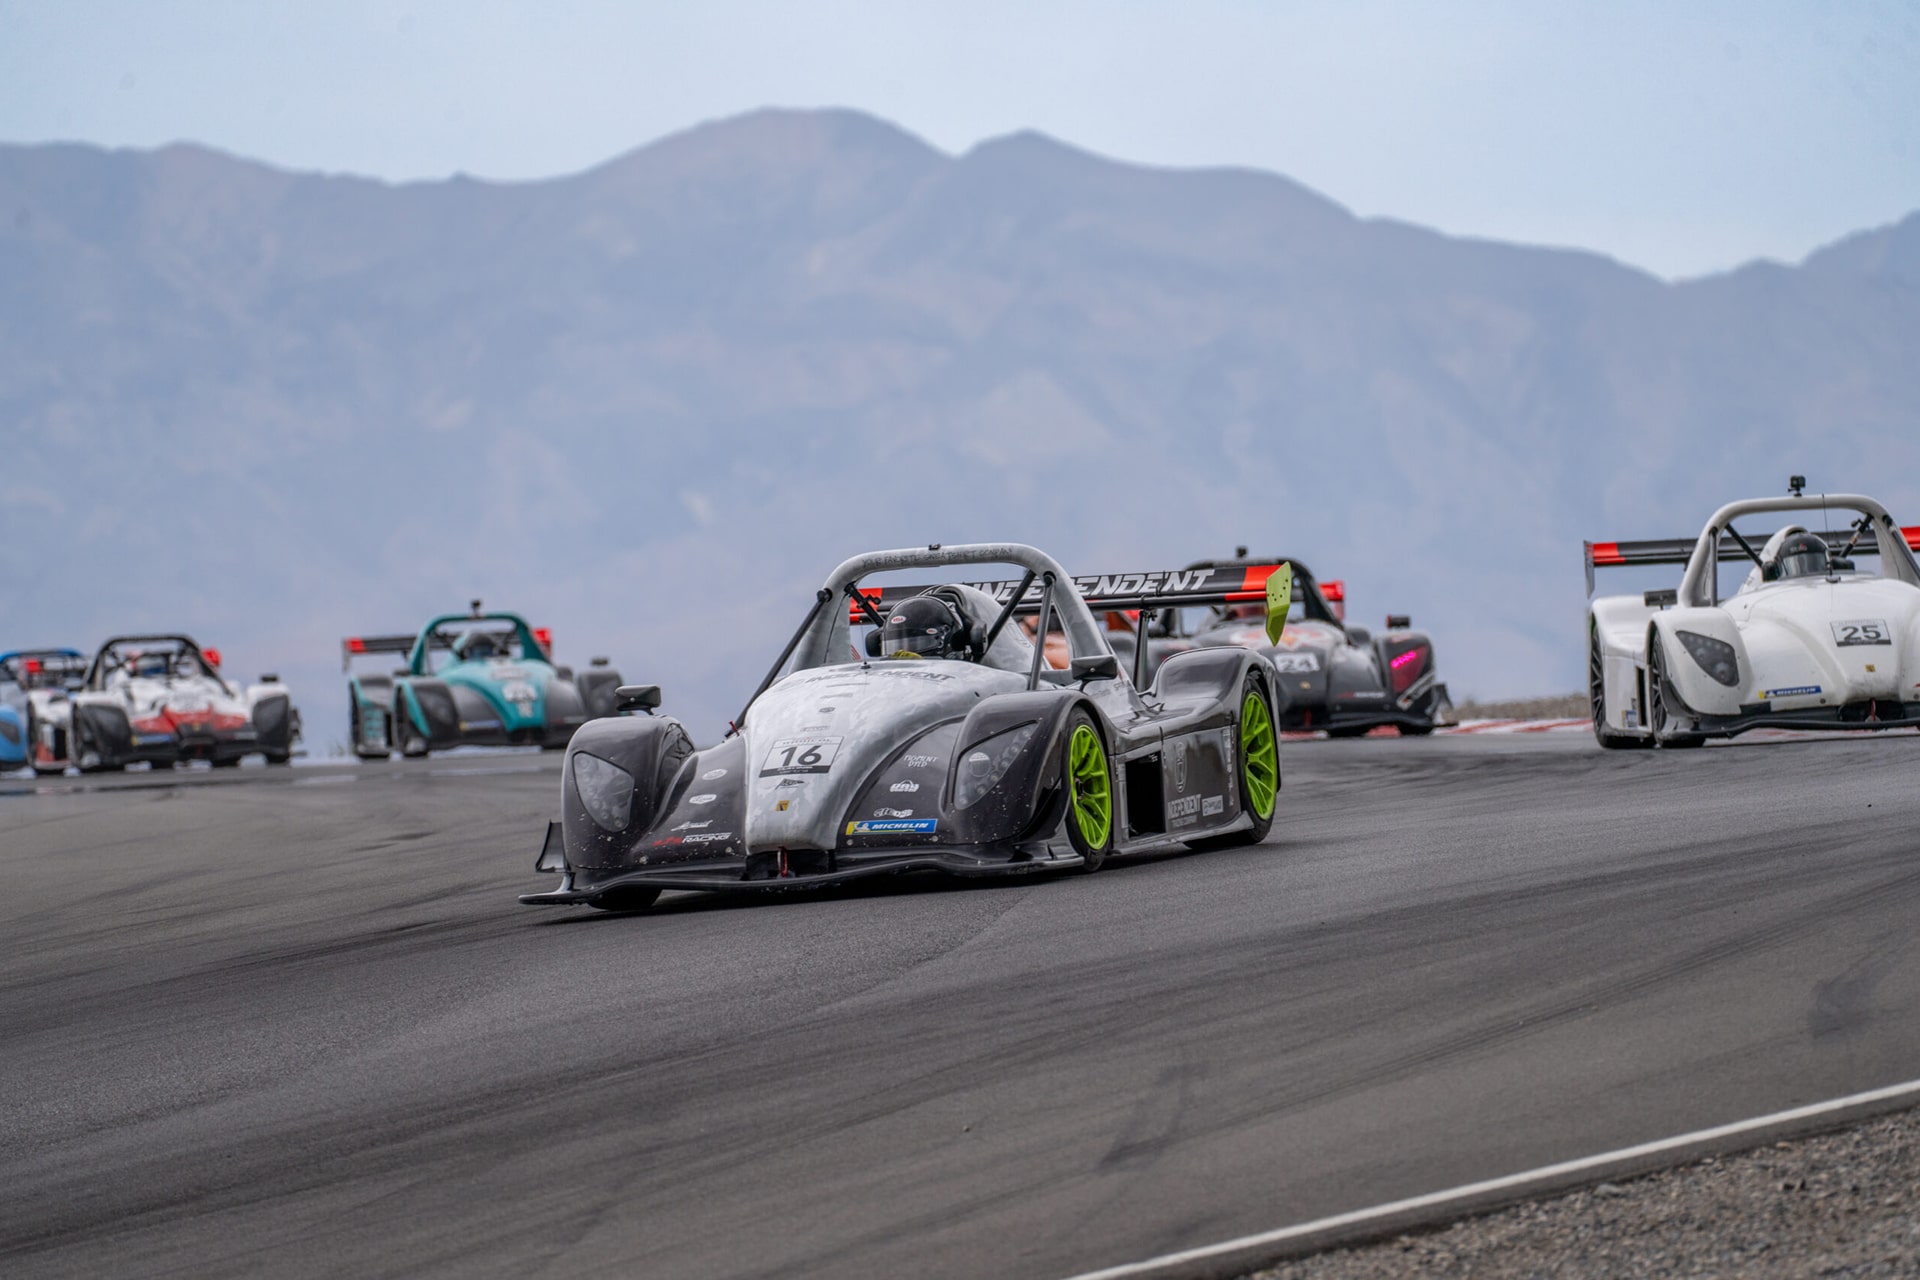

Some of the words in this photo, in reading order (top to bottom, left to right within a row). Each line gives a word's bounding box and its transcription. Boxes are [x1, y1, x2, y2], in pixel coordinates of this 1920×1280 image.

[1841, 624, 1882, 641] 25
[780, 744, 822, 767] 16
[871, 822, 929, 830] MICHELIN
